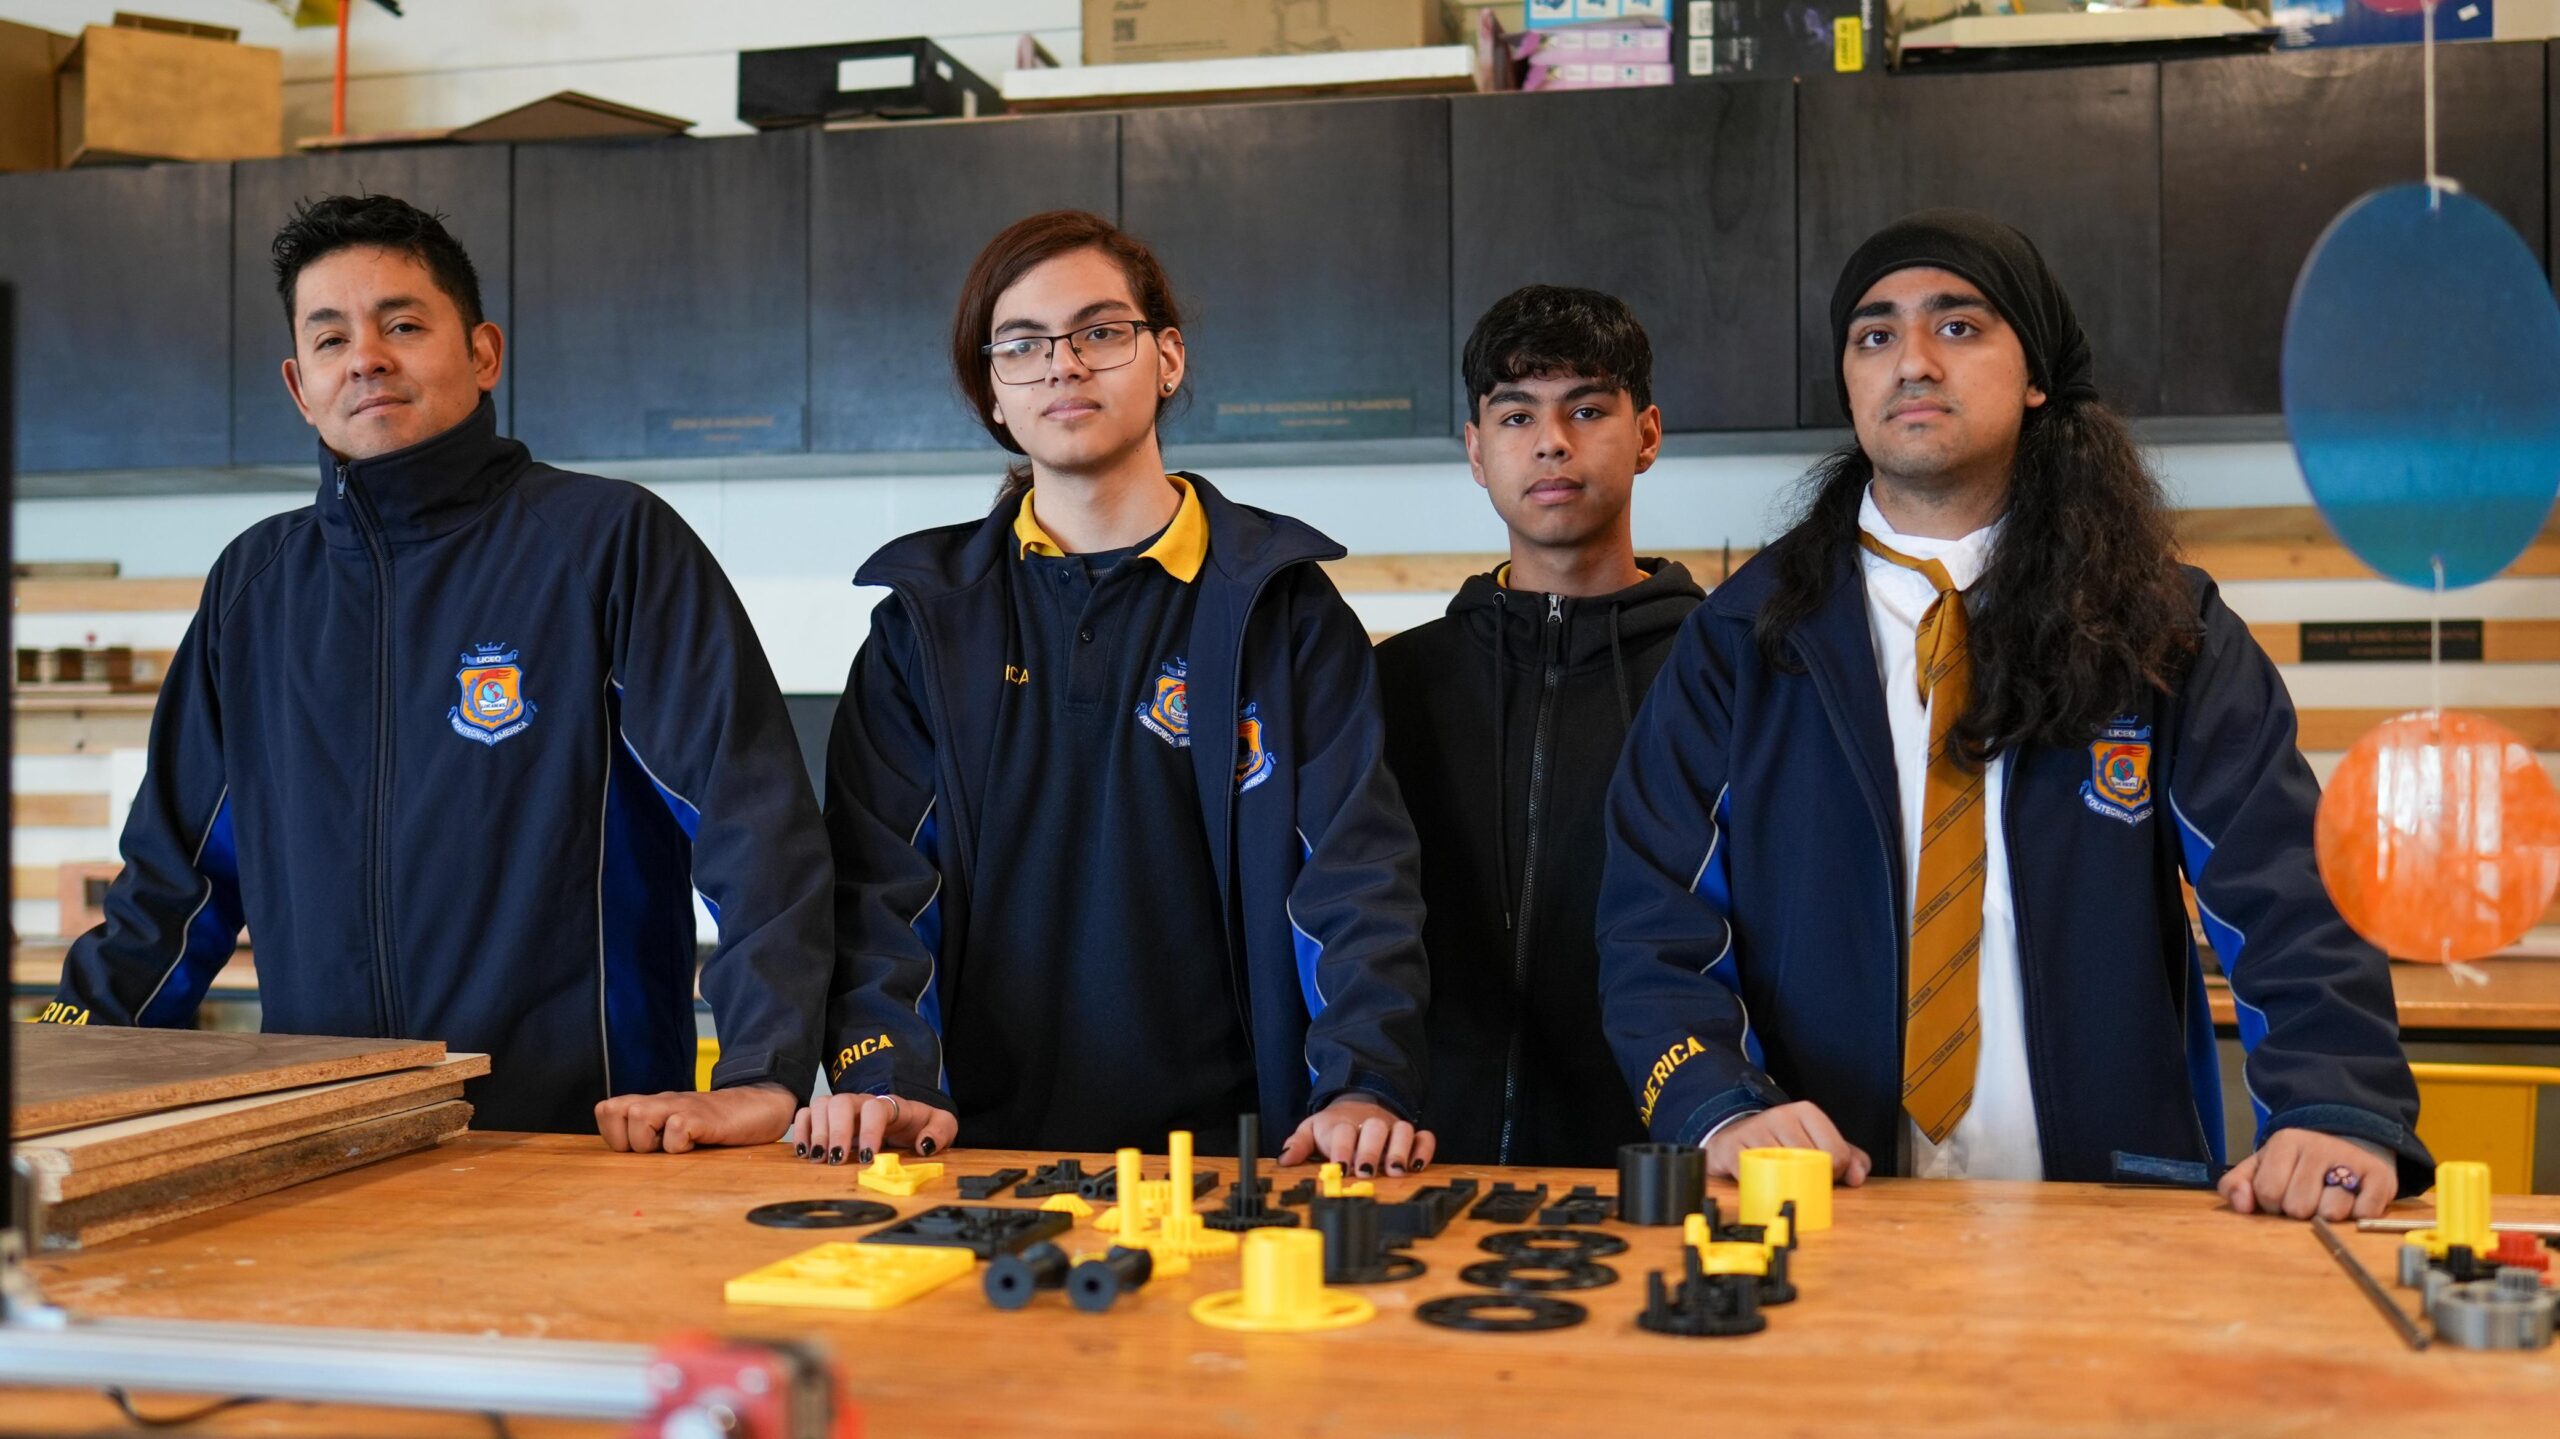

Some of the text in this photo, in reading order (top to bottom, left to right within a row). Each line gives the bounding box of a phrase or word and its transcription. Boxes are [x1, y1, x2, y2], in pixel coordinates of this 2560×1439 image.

[476, 655, 502, 664] LICEO
[451, 717, 529, 744] POLITECNICO AMERICA
[1139, 714, 1175, 744] POLITECNICO
[2108, 729, 2136, 738] LICEO
[2084, 794, 2133, 823] POLITECNICO
